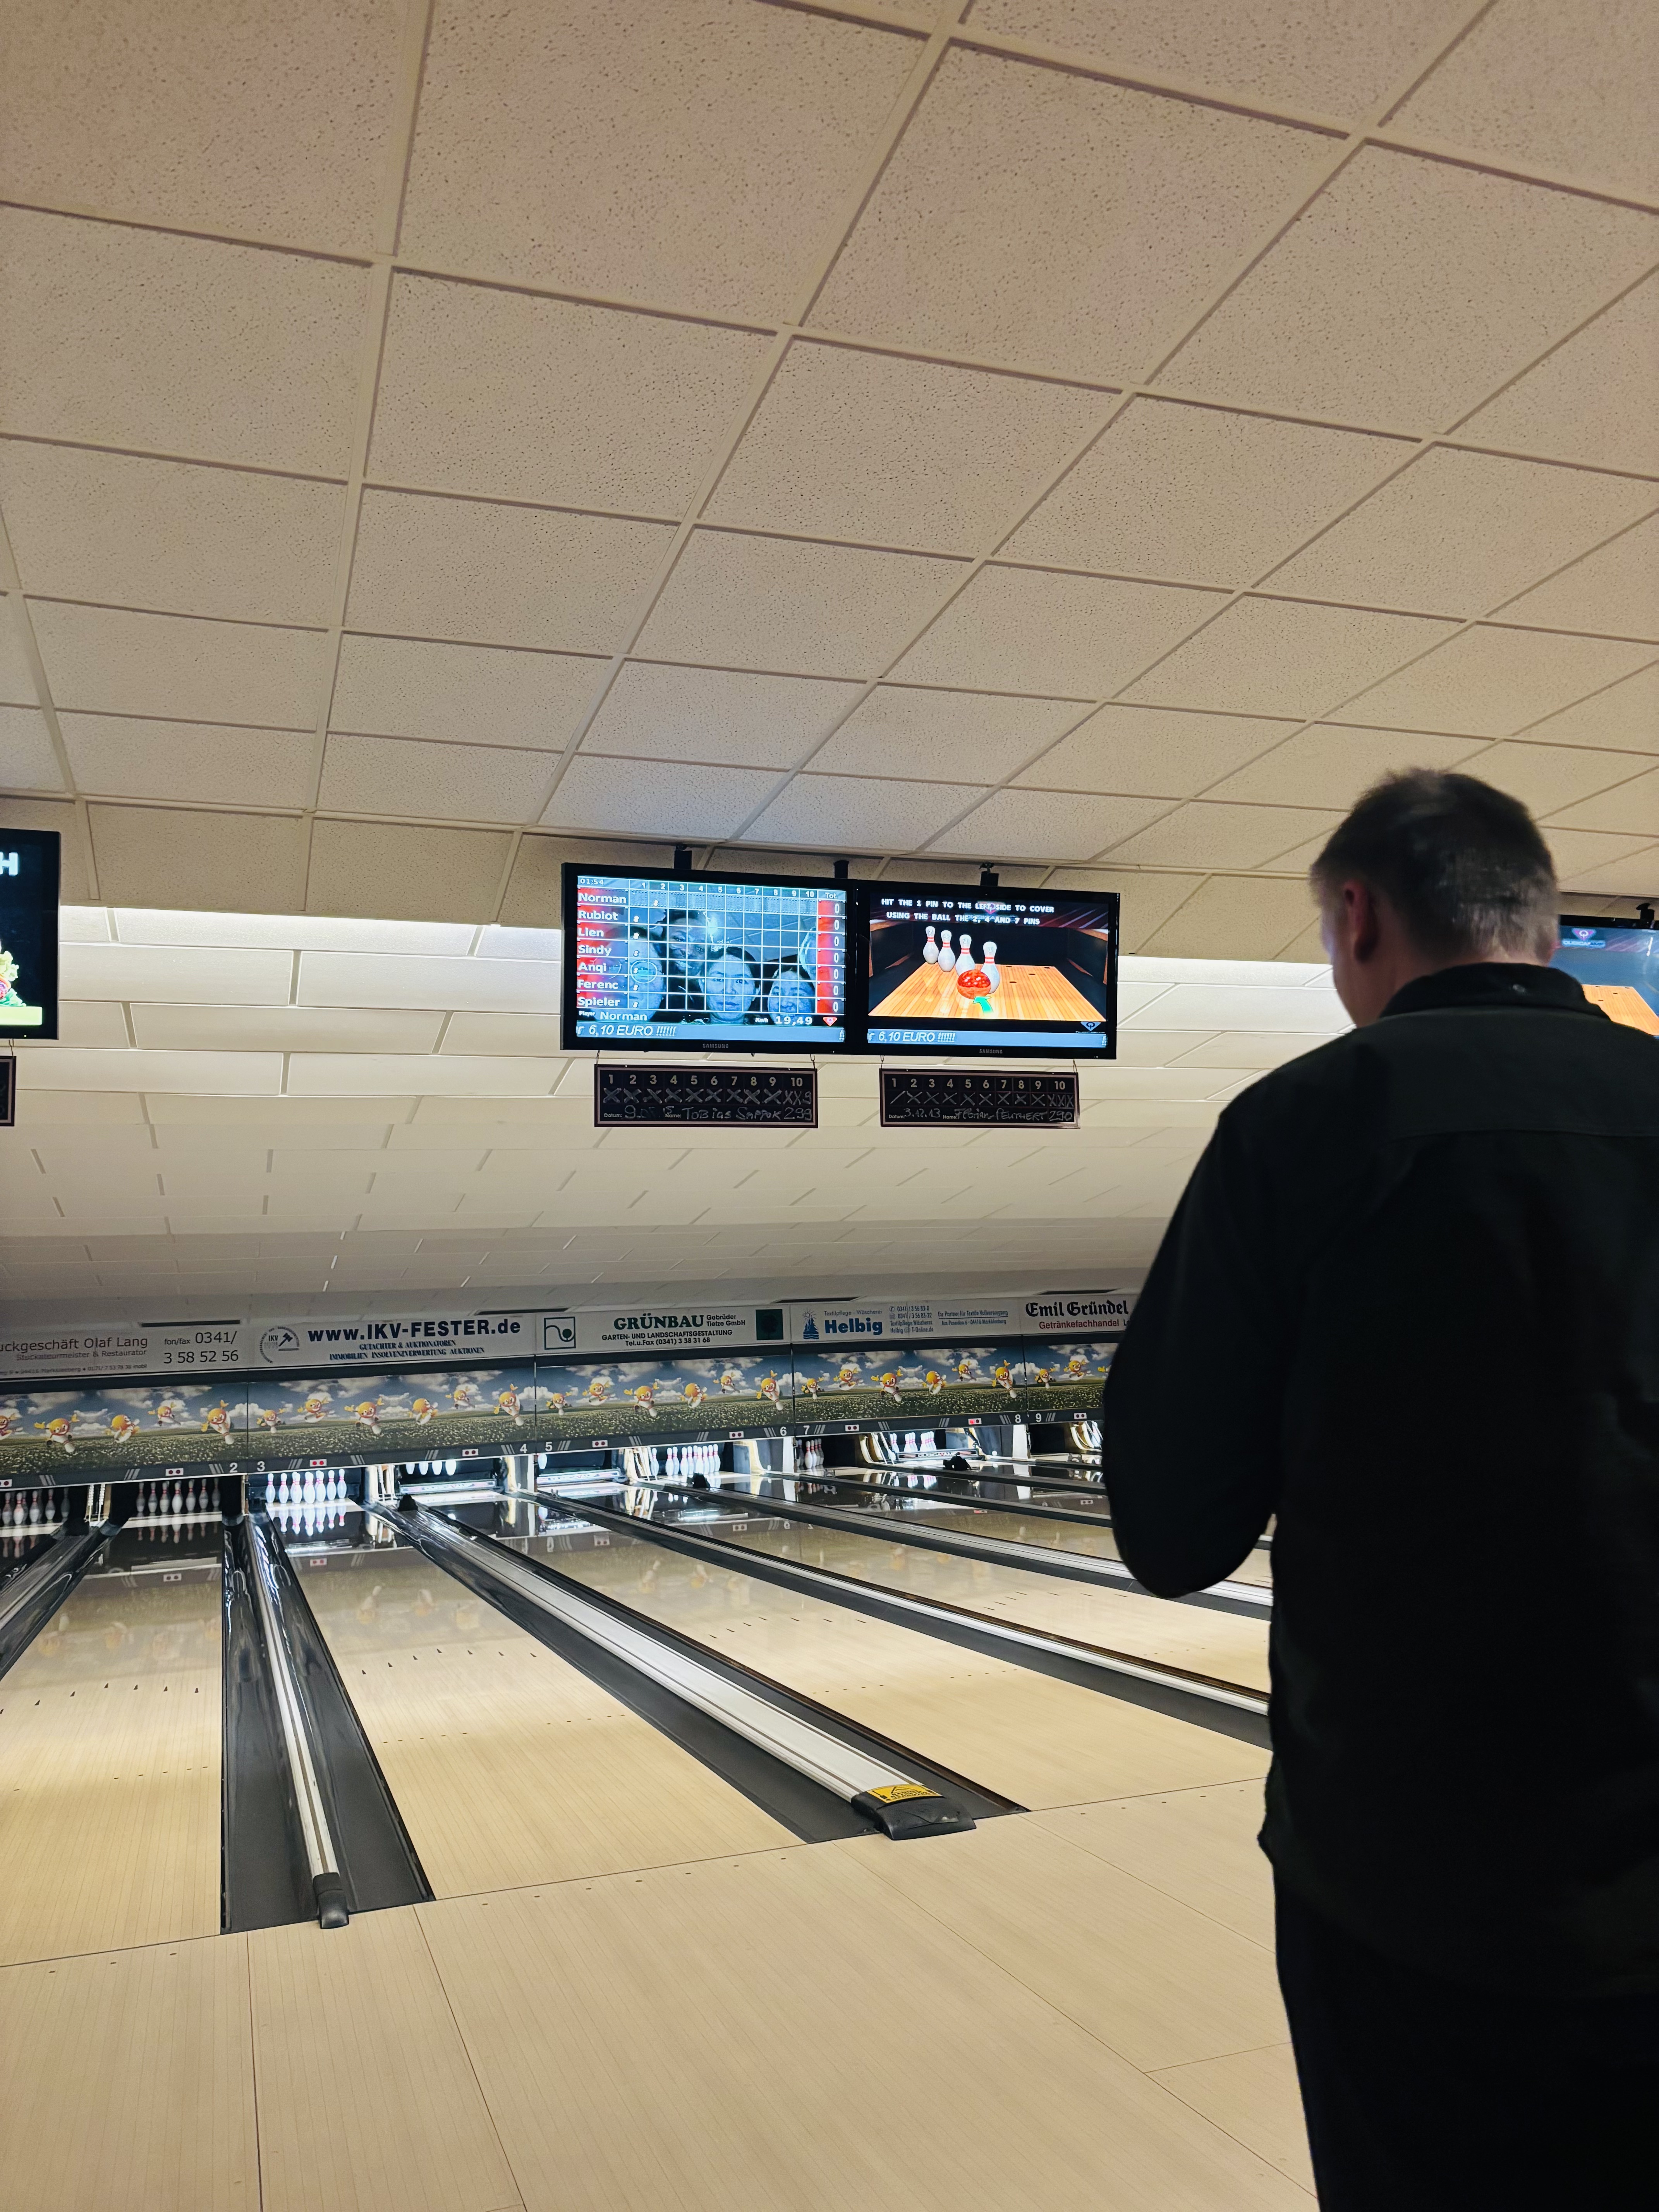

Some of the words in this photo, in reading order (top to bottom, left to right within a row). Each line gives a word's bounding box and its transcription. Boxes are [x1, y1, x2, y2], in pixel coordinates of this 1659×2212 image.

[579, 893, 626, 903] Norman
[834, 904, 840, 914] 0
[579, 910, 618, 920] Rubiot
[834, 921, 839, 930] 0
[578, 927, 604, 937] Lien
[834, 937, 839, 946] 0
[578, 945, 611, 956] Sindy
[834, 953, 839, 963] 0
[833, 970, 839, 979] 0
[577, 979, 618, 989] Ferenc
[833, 986, 838, 996] 0
[578, 997, 620, 1007] Spieler
[833, 1001, 838, 1012] 0
[600, 1012, 647, 1021] Norman
[775, 1016, 812, 1026] 19,49
[589, 1025, 614, 1037] 6,10
[617, 1025, 653, 1036] EURO
[878, 1031, 900, 1042] 6,10
[902, 1032, 935, 1042] EURO
[608, 1075, 613, 1084] 1
[630, 1075, 636, 1084] 2
[650, 1075, 657, 1084] 3
[670, 1075, 677, 1084] 4
[690, 1075, 697, 1085] 5
[711, 1076, 718, 1085] 6
[732, 1076, 738, 1085] 7
[750, 1077, 757, 1086] 8
[769, 1077, 776, 1086] 9
[791, 1077, 803, 1087] 10
[892, 1078, 896, 1087] 1
[911, 1079, 917, 1087] 2
[929, 1079, 935, 1087] 3
[946, 1079, 953, 1088] 4
[965, 1079, 971, 1088] 5
[983, 1080, 989, 1088] 6
[1001, 1080, 1007, 1089] 7
[1018, 1080, 1024, 1089] 8
[1035, 1081, 1041, 1089] 9
[1055, 1081, 1065, 1090] 10
[784, 1107, 812, 1120] 299
[1049, 1111, 1073, 1121] 290
[1025, 1302, 1064, 1316] Emil
[1067, 1300, 1129, 1316] Gründel
[614, 1313, 704, 1330] GRÜNBAU
[825, 1317, 883, 1335] Helbig
[1039, 1319, 1119, 1329] Getränkefachhandel
[308, 1319, 521, 1342] www.IKV-FESTER.de
[647, 1330, 733, 1339] LANDSCHAFTSGESTALTUNG
[84, 1337, 112, 1348] Olaf
[117, 1337, 148, 1348] Lang
[195, 1331, 237, 1345] 0341/
[359, 1342, 397, 1350] GUTACHTER
[163, 1353, 172, 1364] 3
[177, 1352, 195, 1363] 58
[200, 1350, 217, 1362] 52
[222, 1350, 239, 1362] 56
[1015, 1414, 1021, 1423] 8
[1036, 1413, 1042, 1422] 9
[780, 1426, 787, 1436] 6
[803, 1425, 810, 1435] 7
[519, 1443, 528, 1453] 4
[545, 1441, 552, 1451] 5
[229, 1463, 238, 1473] 2
[257, 1461, 265, 1471] 3
